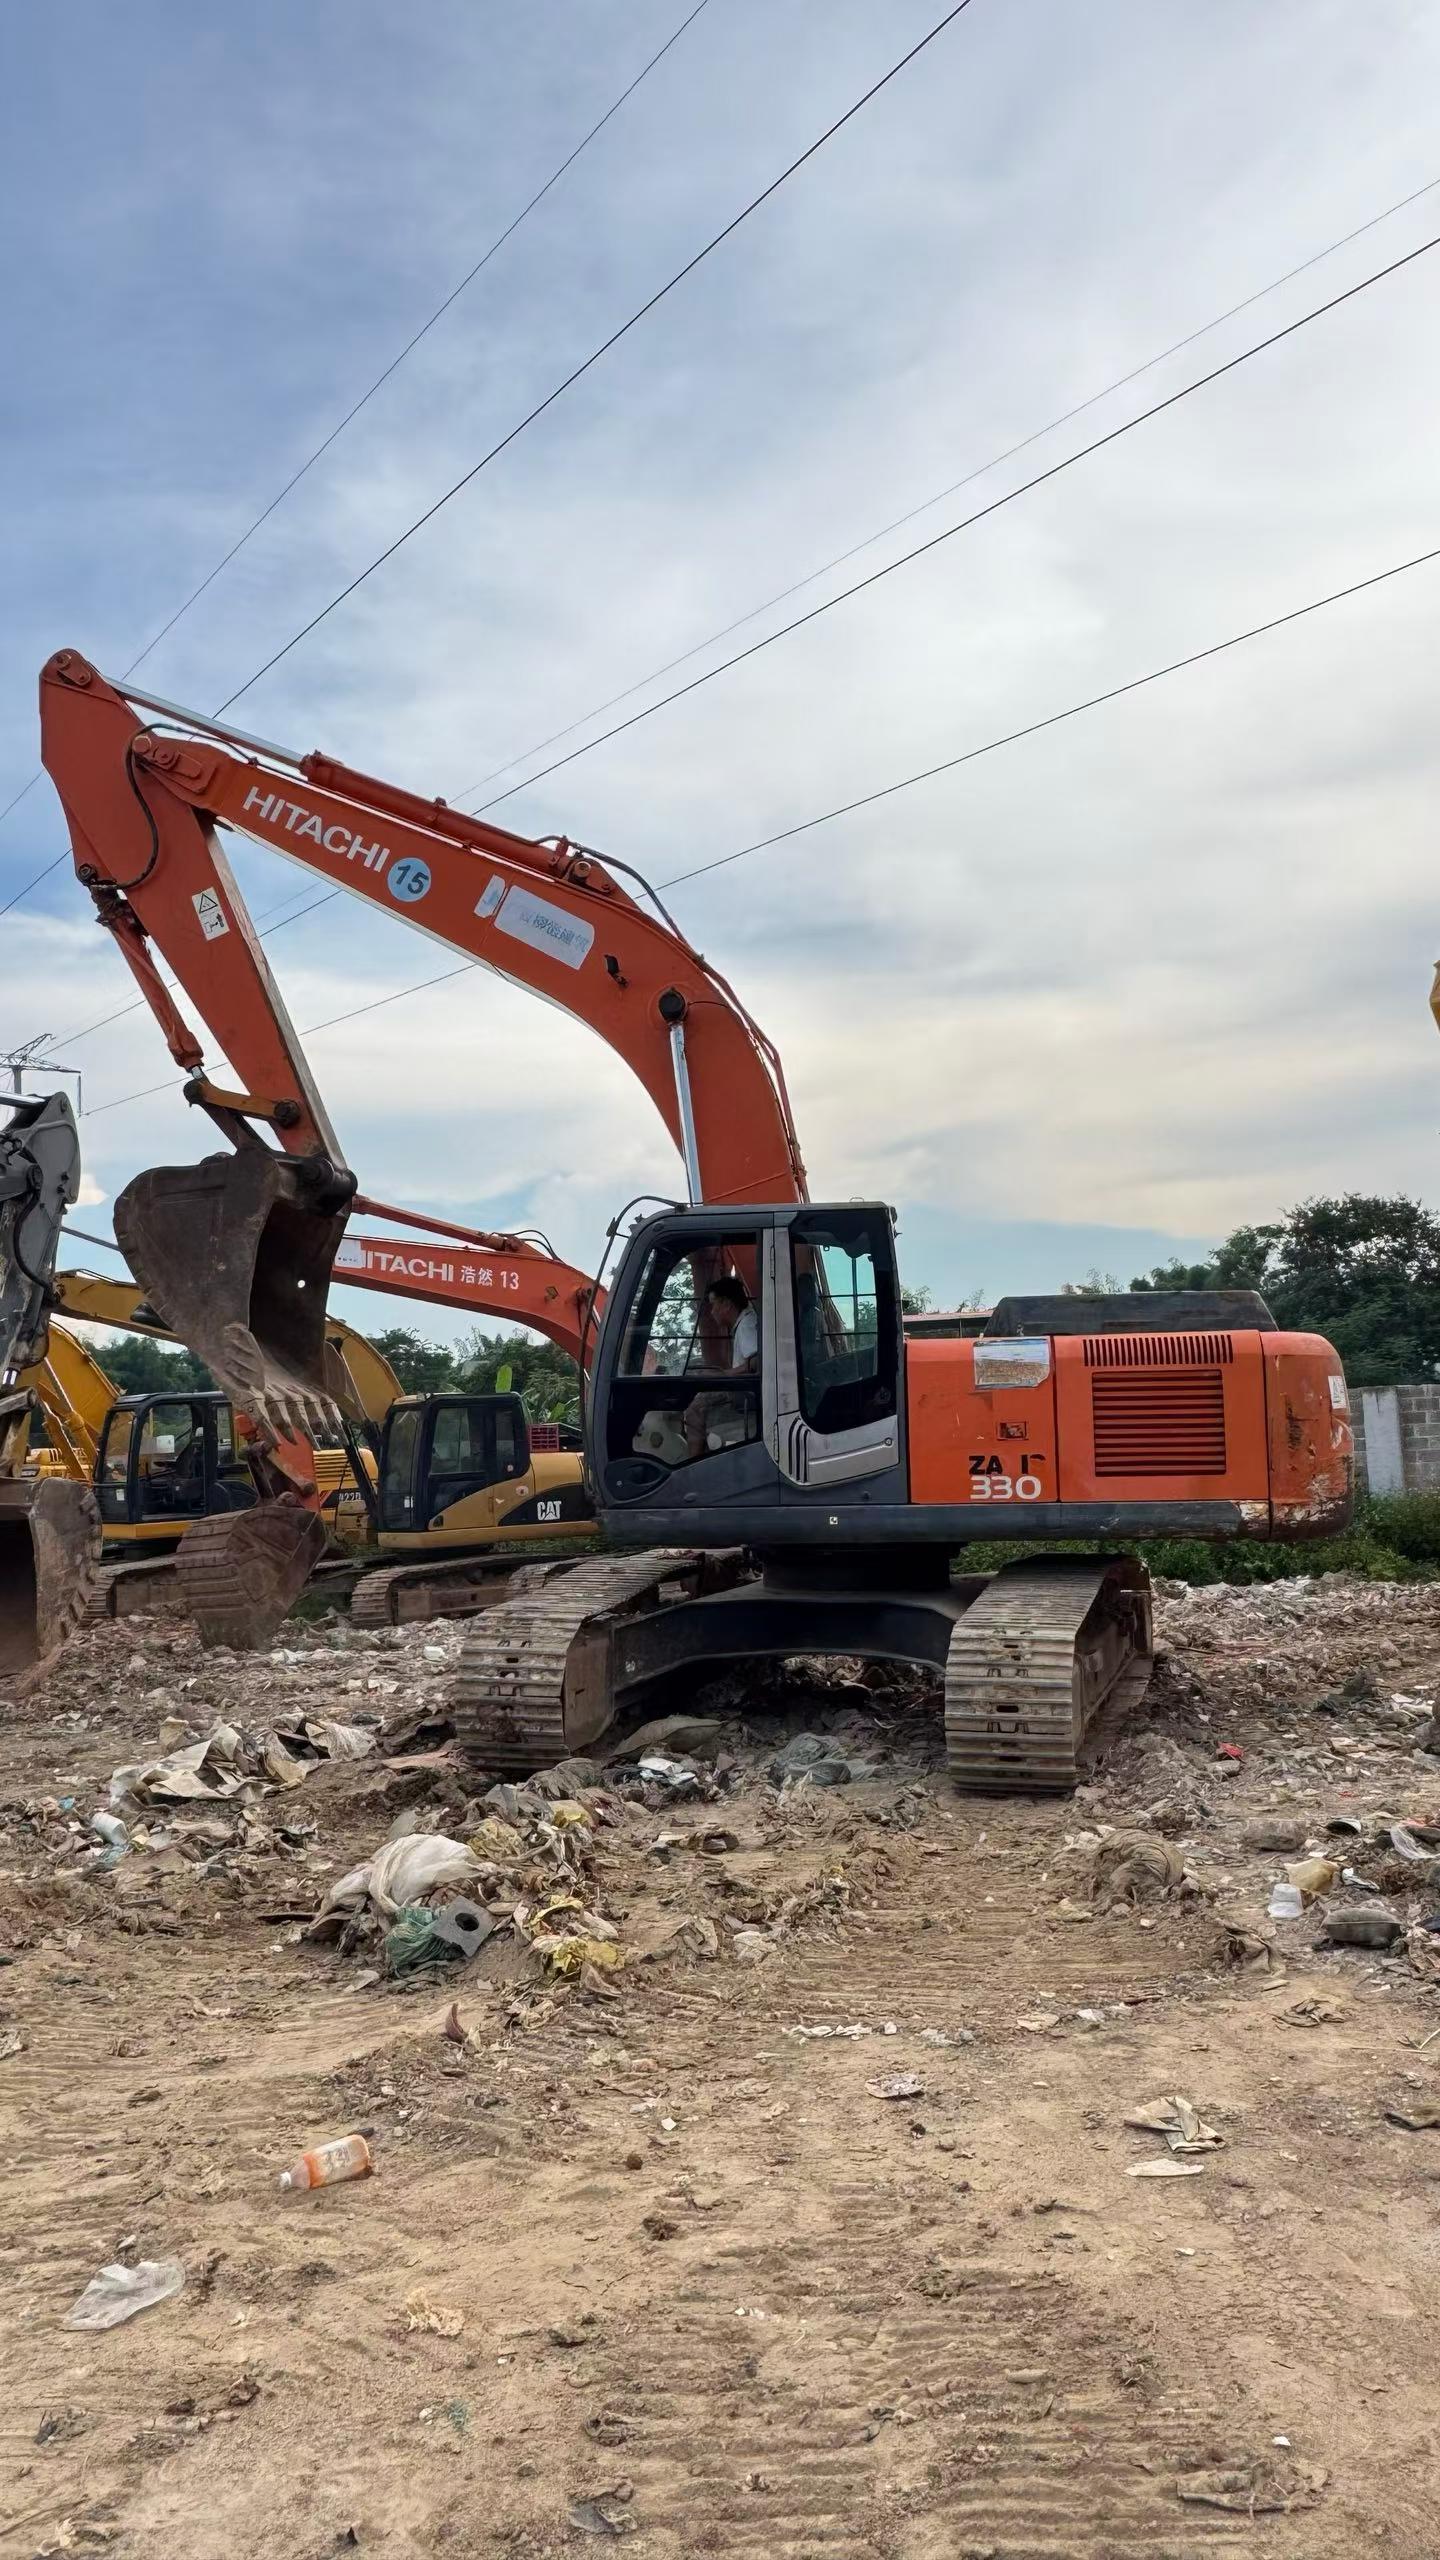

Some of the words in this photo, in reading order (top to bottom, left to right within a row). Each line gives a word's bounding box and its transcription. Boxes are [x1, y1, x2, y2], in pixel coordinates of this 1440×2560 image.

[243, 786, 391, 873] HITACHI
[396, 864, 430, 895] 15
[500, 1271, 520, 1290] 13
[970, 1475, 1042, 1500] 330
[536, 1500, 562, 1521] CAT
